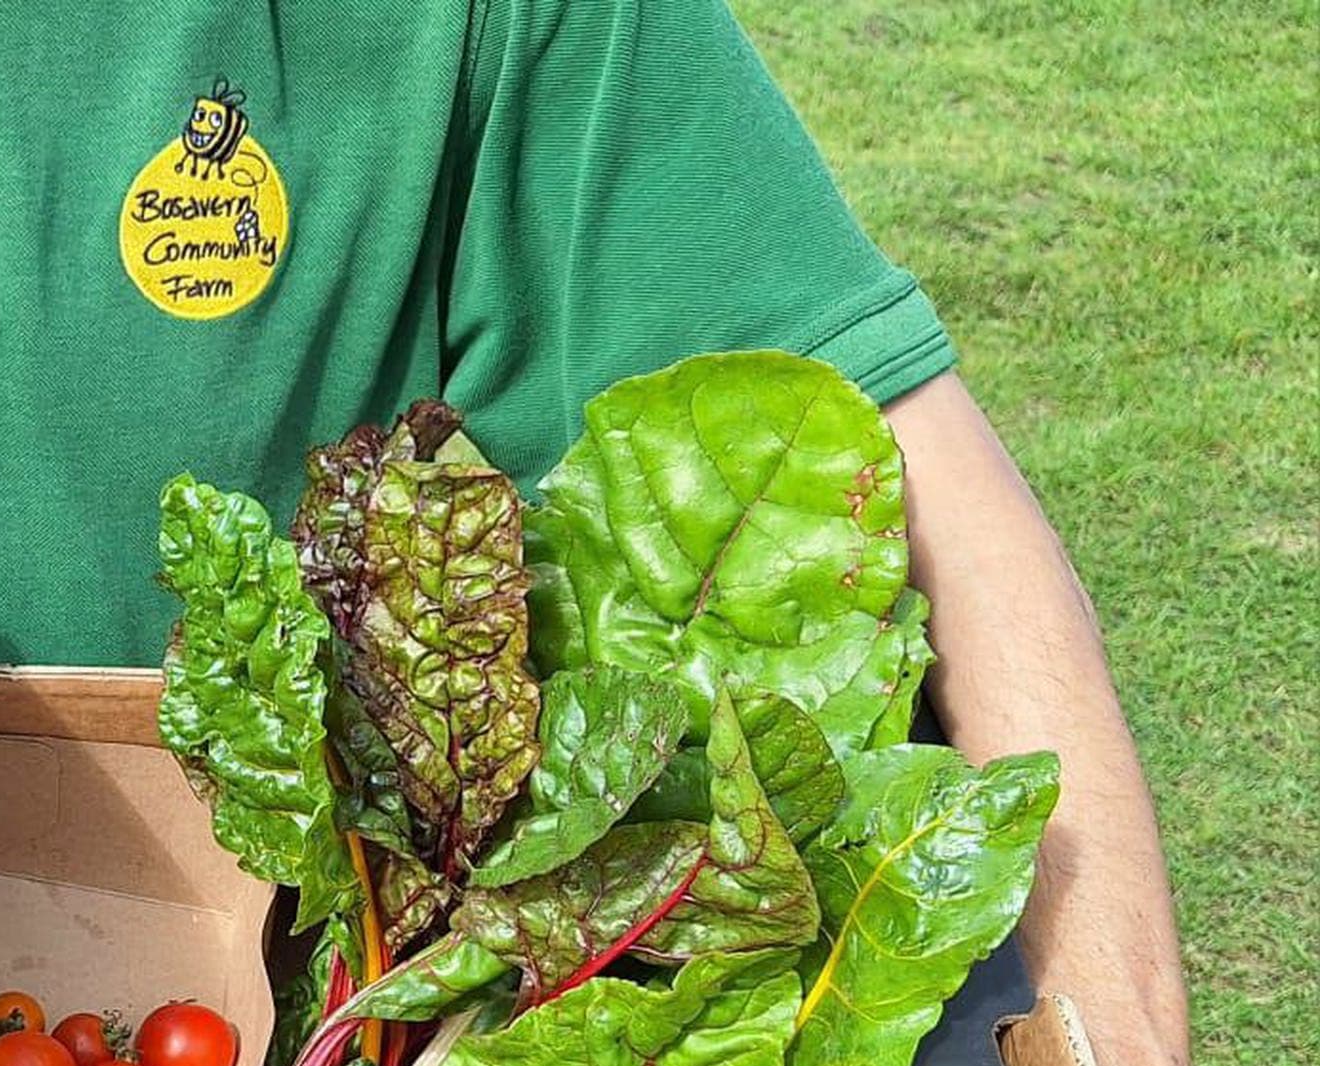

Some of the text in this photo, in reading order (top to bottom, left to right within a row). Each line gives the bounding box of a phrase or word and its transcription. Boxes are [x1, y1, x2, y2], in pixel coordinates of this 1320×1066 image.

[131, 190, 252, 222] Bosavern
[144, 232, 277, 266] Community
[161, 275, 233, 301] Farm
